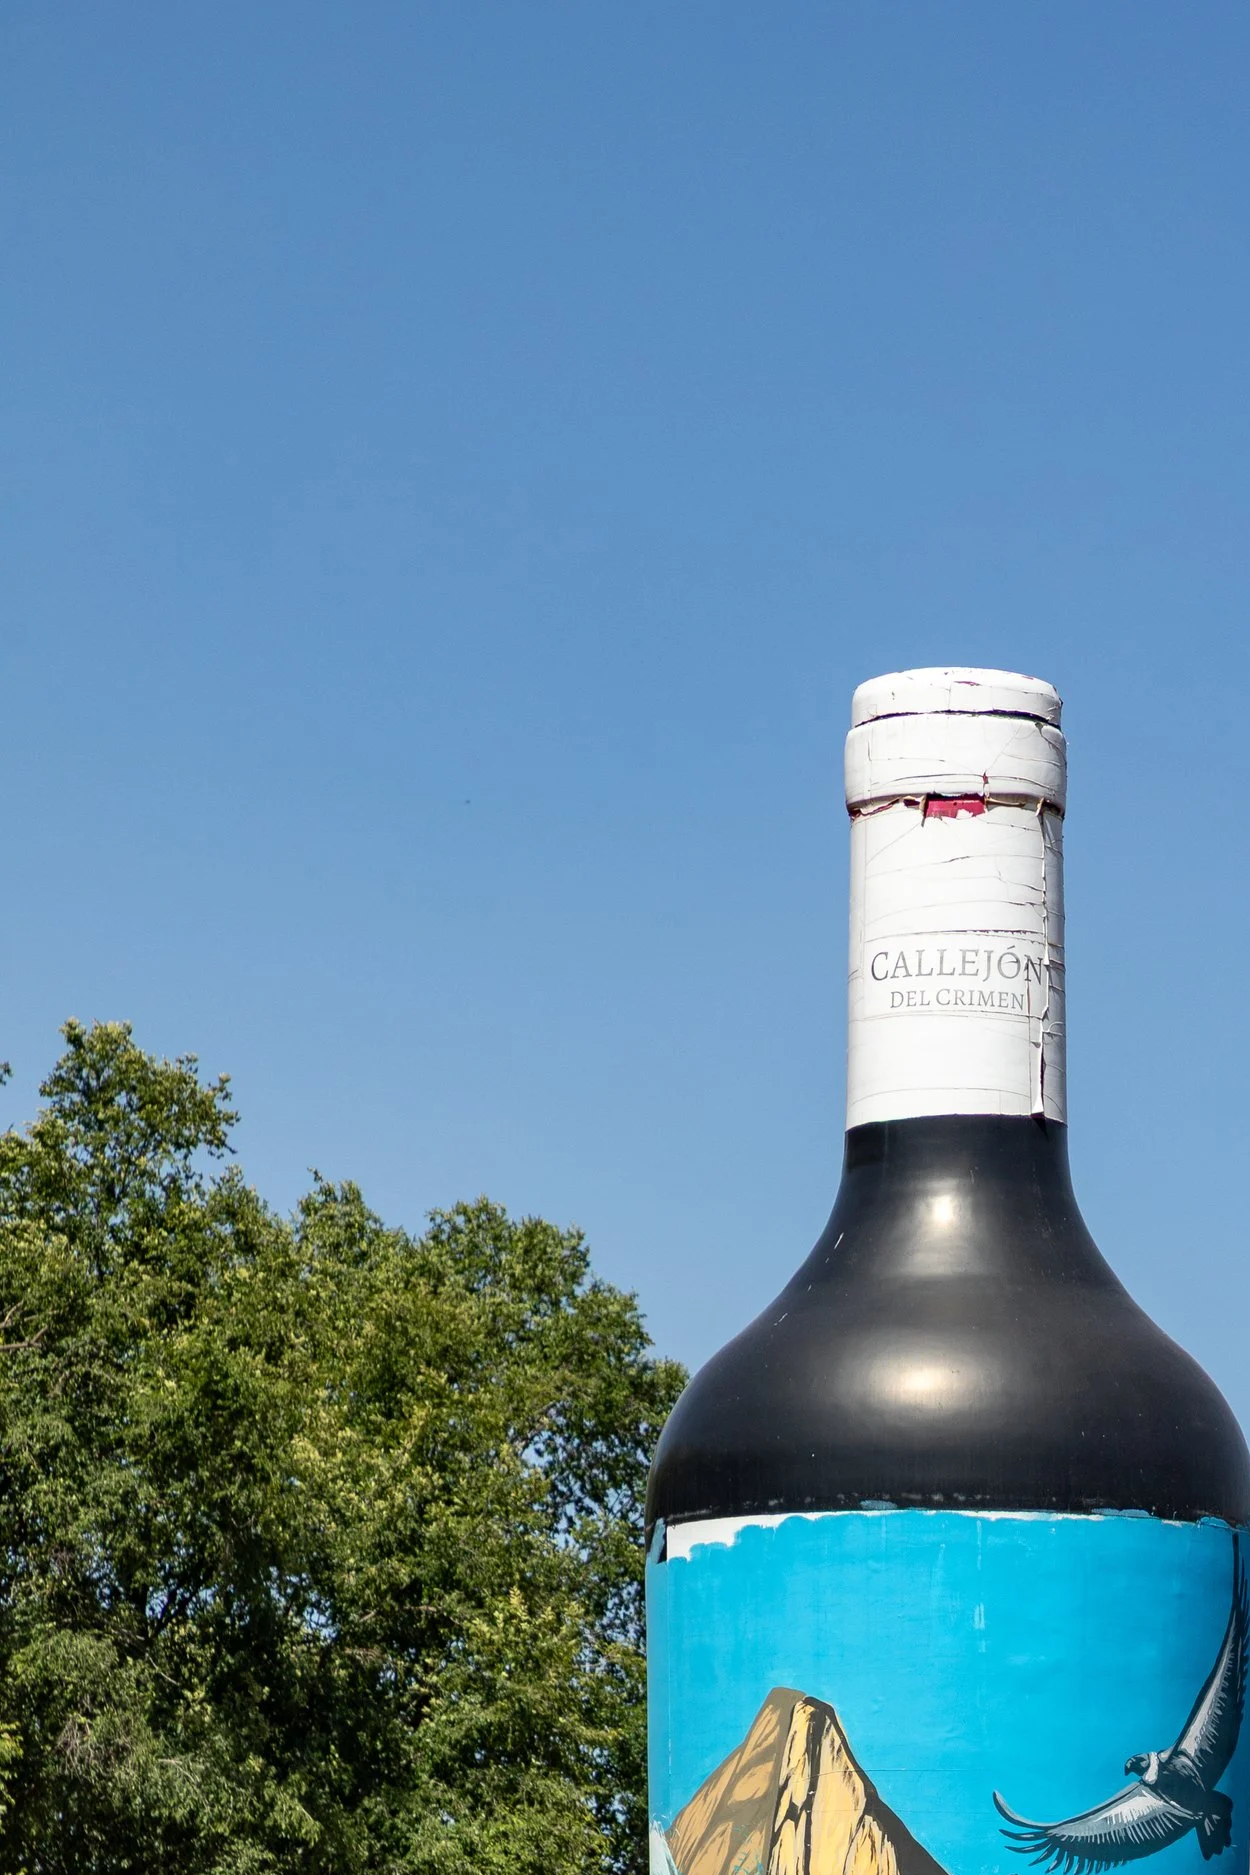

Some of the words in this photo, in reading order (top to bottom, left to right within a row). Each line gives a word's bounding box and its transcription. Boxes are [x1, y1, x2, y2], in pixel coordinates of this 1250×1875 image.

[871, 945, 1043, 985] CALLEJÓN
[890, 990, 931, 1008] DEL
[936, 988, 1024, 1010] CRIMEN
